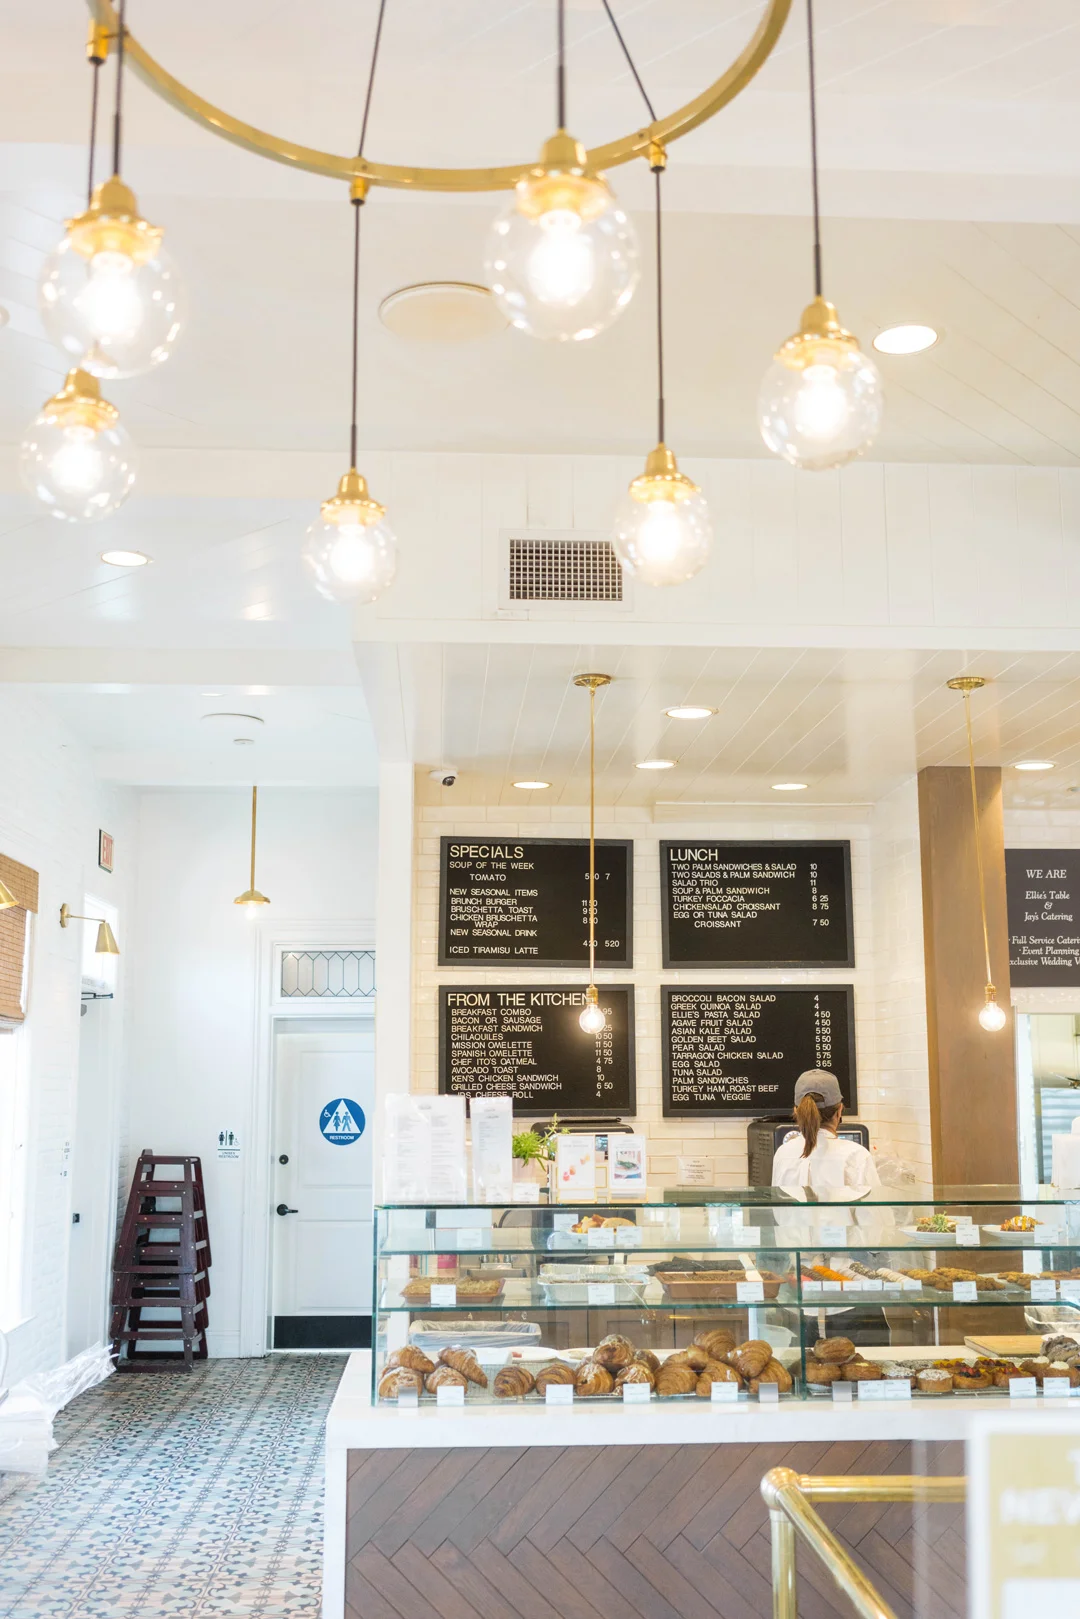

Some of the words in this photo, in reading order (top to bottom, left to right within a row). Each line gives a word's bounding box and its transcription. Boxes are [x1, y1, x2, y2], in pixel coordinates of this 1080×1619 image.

[450, 846, 523, 858] SPECIALS
[671, 849, 718, 861] LUNCH
[1026, 870, 1042, 878] WE
[1046, 870, 1066, 878] ARE
[1026, 891, 1046, 899] Ellie's
[1049, 891, 1070, 899] Table
[1024, 912, 1039, 922] Jay's
[1041, 912, 1073, 921] Catering
[1012, 936, 1027, 944] Full
[1029, 936, 1054, 944] Service
[1022, 946, 1043, 954] Event
[1045, 946, 1079, 956] Planning
[1041, 957, 1072, 966] Wedding
[448, 994, 490, 1006] FROM
[498, 994, 525, 1006] THE
[512, 1091, 533, 1100] ROLL
